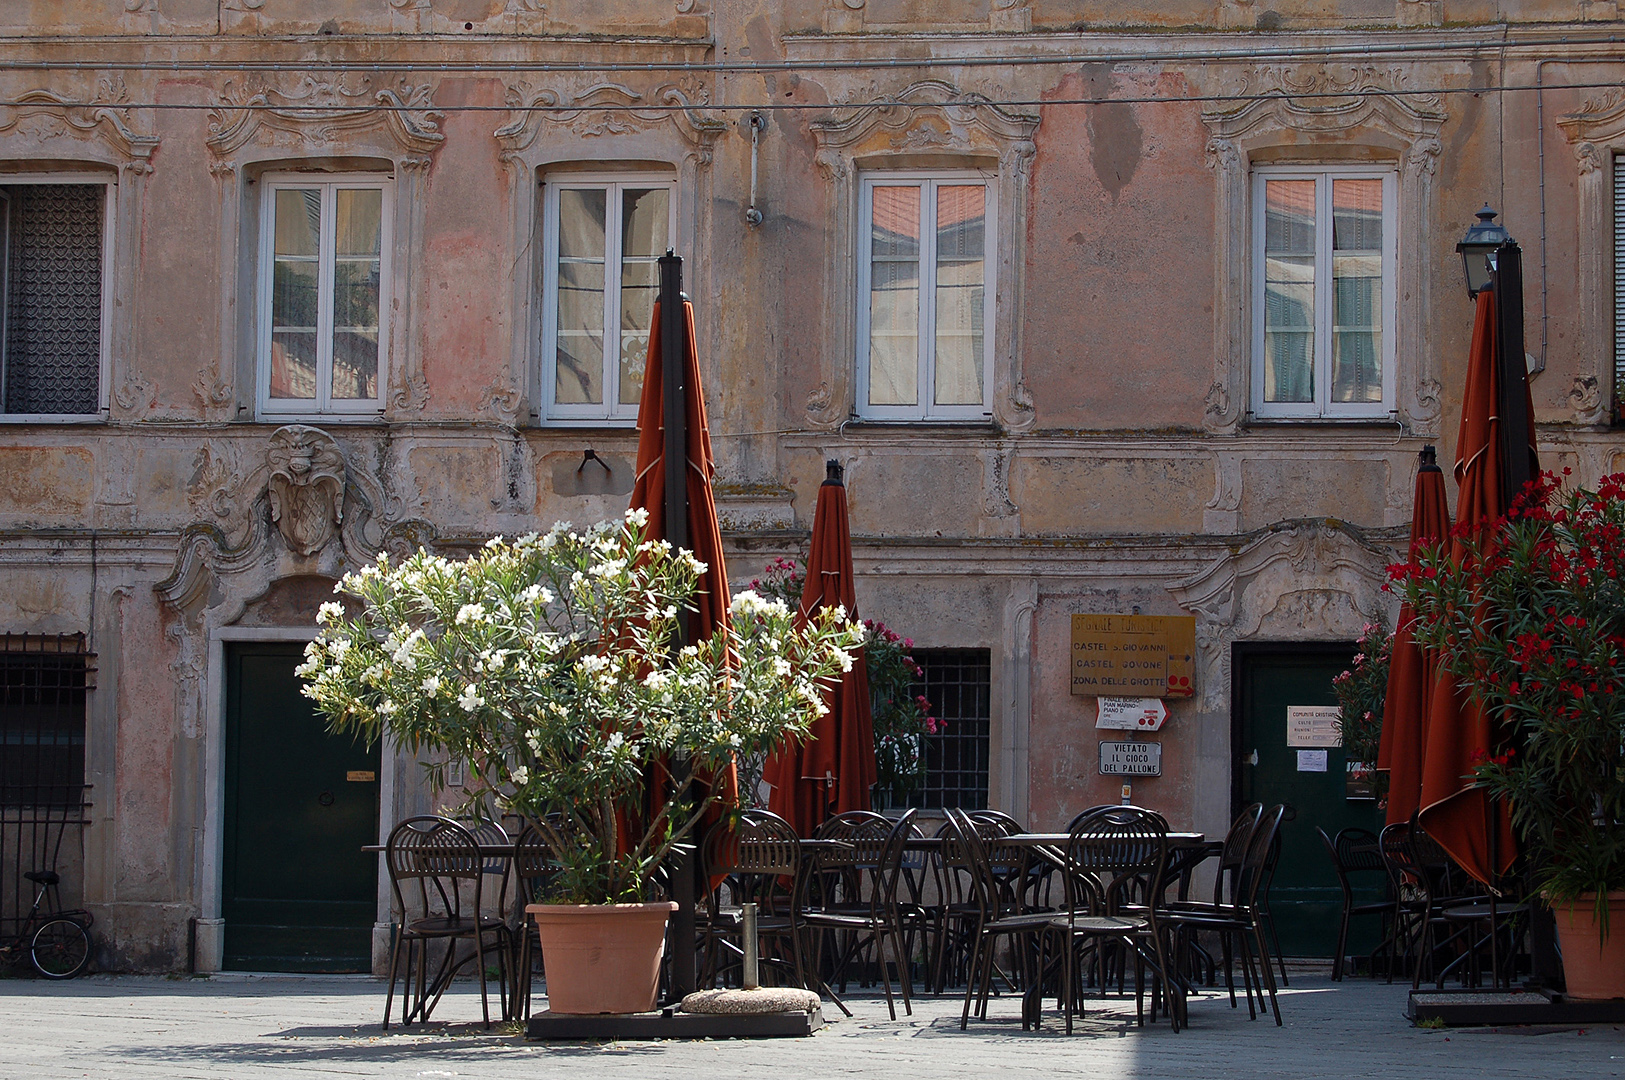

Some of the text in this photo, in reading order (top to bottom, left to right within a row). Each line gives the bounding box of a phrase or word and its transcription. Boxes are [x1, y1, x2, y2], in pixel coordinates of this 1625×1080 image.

[1076, 617, 1112, 631] SEGNALE
[1073, 642, 1108, 651] CASTEL
[1122, 643, 1166, 652] GIOVANNI
[1076, 660, 1162, 669] CASTEL GOVONE
[1073, 676, 1166, 687] ZONA DELLE GROTTE
[1114, 744, 1147, 752] VIETATO
[1112, 754, 1149, 763] IL GIOCO
[1104, 764, 1156, 773] DEL PALLONE
